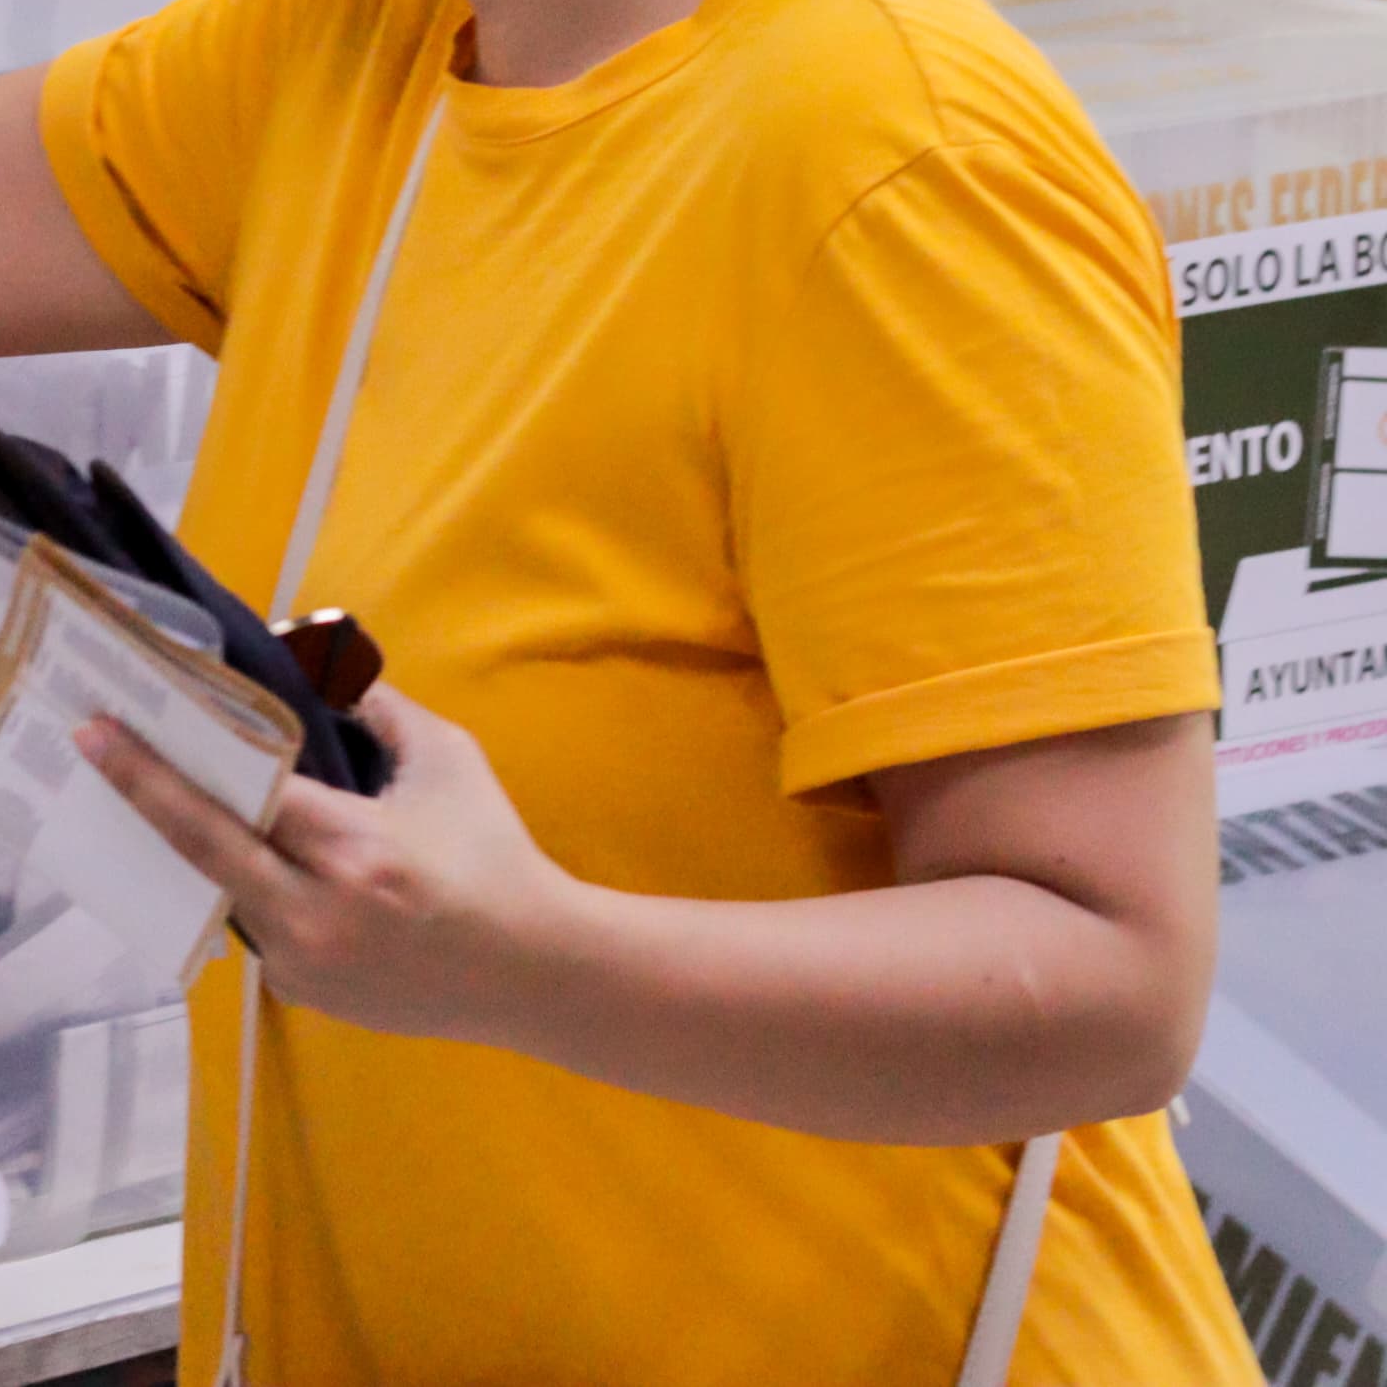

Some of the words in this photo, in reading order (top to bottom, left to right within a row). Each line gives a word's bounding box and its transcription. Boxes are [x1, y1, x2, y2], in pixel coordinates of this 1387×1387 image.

[1182, 248, 1282, 307] SOLO
[1295, 239, 1341, 287] LA
[1244, 644, 1387, 705] AYUNTA
